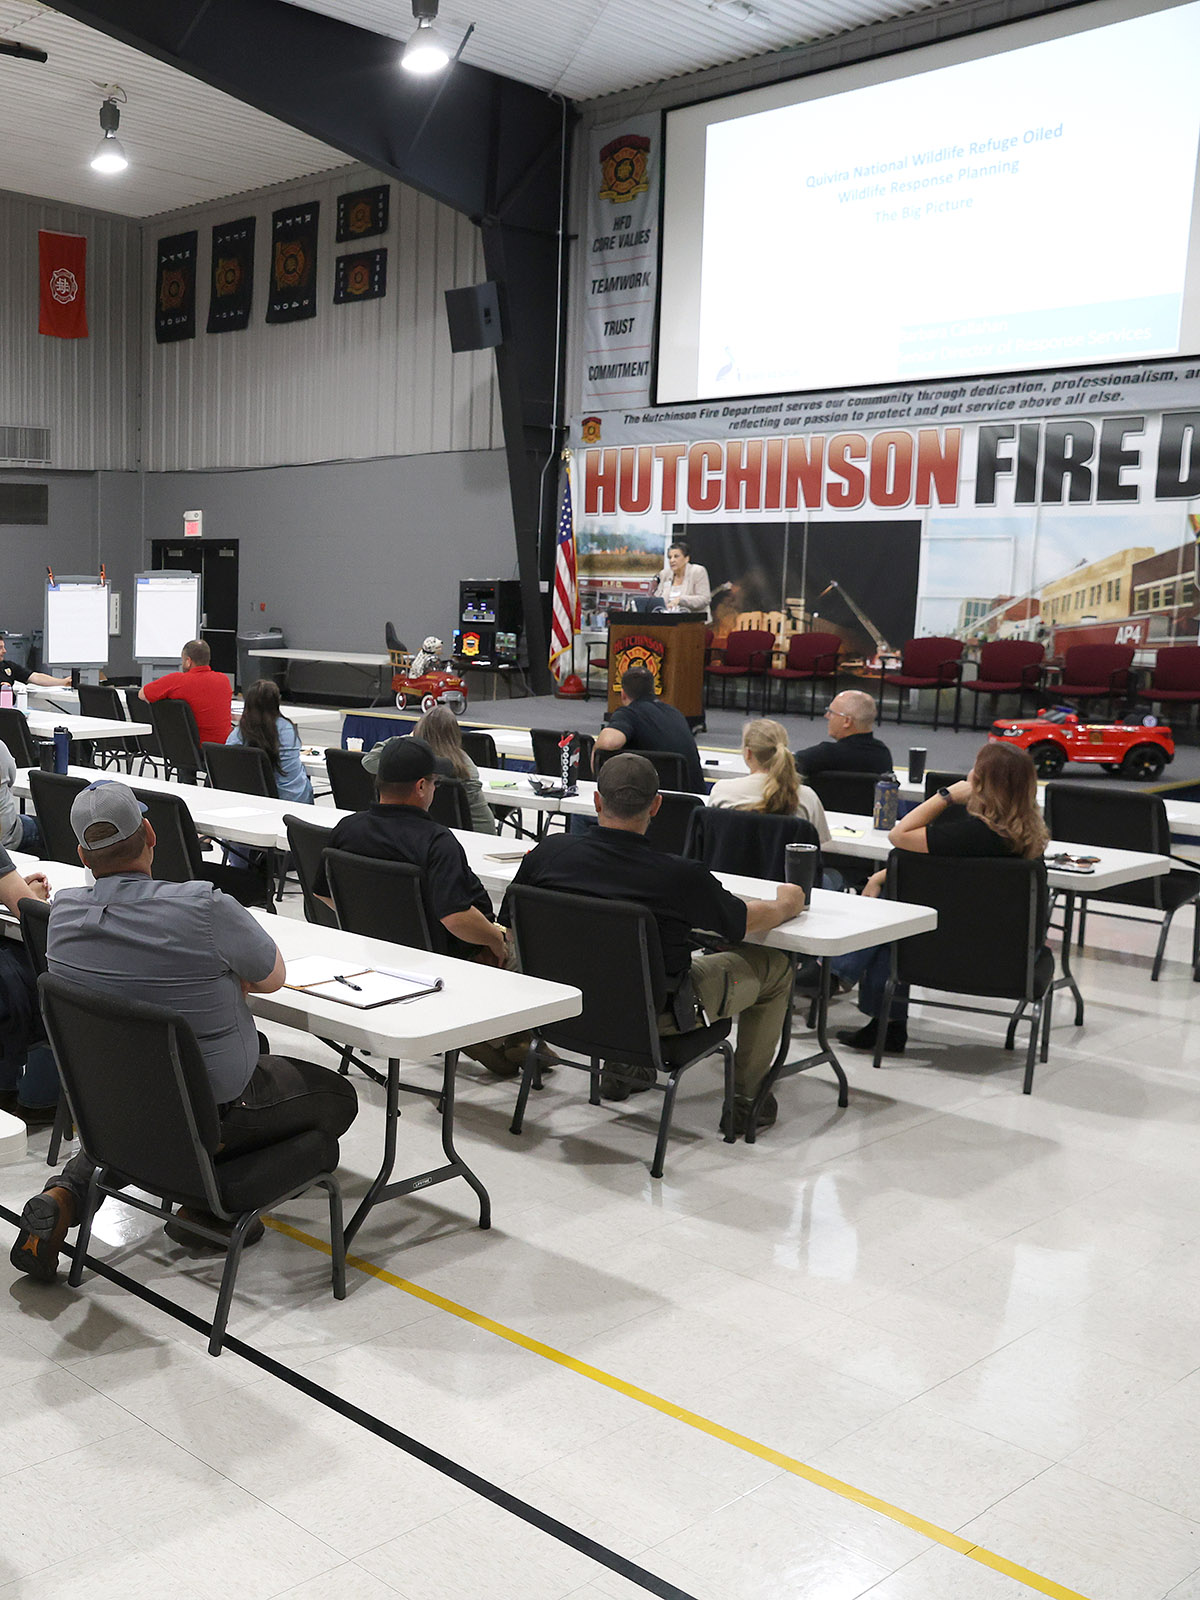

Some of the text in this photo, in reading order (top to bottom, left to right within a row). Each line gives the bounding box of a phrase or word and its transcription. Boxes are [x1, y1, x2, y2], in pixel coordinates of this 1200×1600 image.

[806, 123, 1063, 189] Quivira National Wildlife Refuge Oiled
[837, 159, 1020, 204] Wildlife Response Planning
[612, 215, 632, 231] HFD
[874, 197, 974, 223] The Big Picture
[592, 229, 651, 253] CORE VALUES
[591, 271, 651, 295] TEAMWORK
[604, 318, 635, 336] TRUST
[997, 339, 1011, 354] of
[1016, 333, 1085, 353] Response
[1088, 326, 1152, 343] Services
[588, 361, 649, 381] COMMITMENT
[624, 414, 640, 424] The
[642, 410, 696, 423] Hutchinson
[700, 407, 720, 418] Fire
[722, 402, 784, 418] Department
[786, 401, 822, 412] serves
[825, 399, 845, 409] our
[847, 391, 913, 407] community
[917, 387, 966, 401] through
[970, 381, 1047, 397] dedication,
[1051, 369, 1179, 393] professionalism,
[729, 390, 1125, 430] reflecting our passion to protect and put service above all else.
[584, 427, 963, 516] HUTCHINSON
[974, 415, 1146, 508] FIRE
[1115, 625, 1142, 645] AP4
